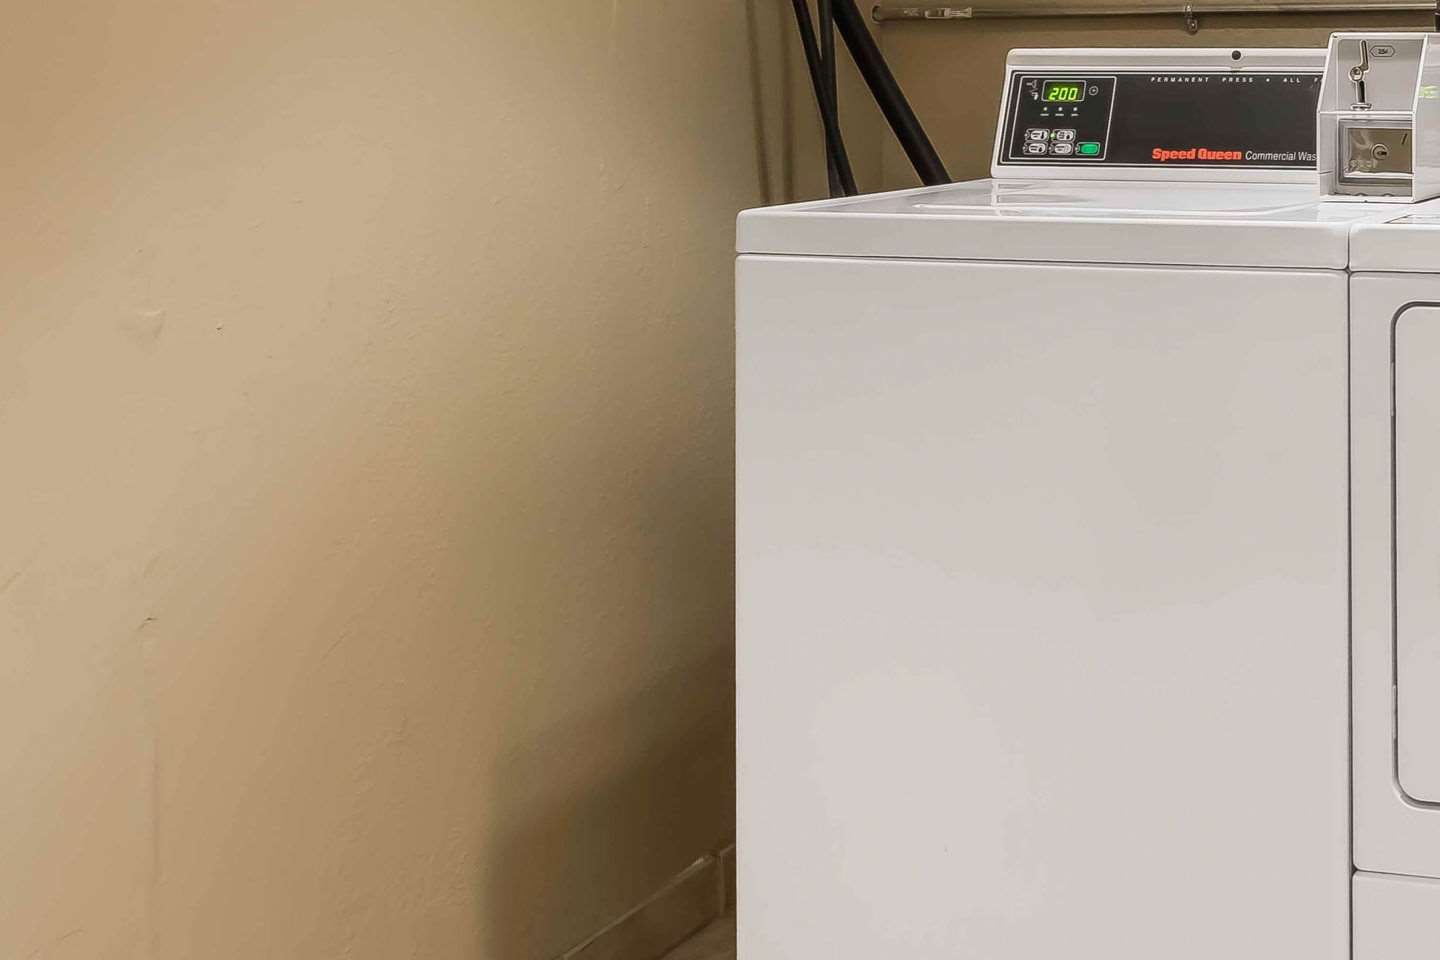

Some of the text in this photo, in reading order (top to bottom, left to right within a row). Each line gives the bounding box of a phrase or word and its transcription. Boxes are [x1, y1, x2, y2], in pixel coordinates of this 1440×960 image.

[1048, 87, 1079, 101] 200
[1151, 147, 1197, 162] Speed
[1197, 147, 1243, 161] Queen
[1245, 150, 1297, 162] Commercial
